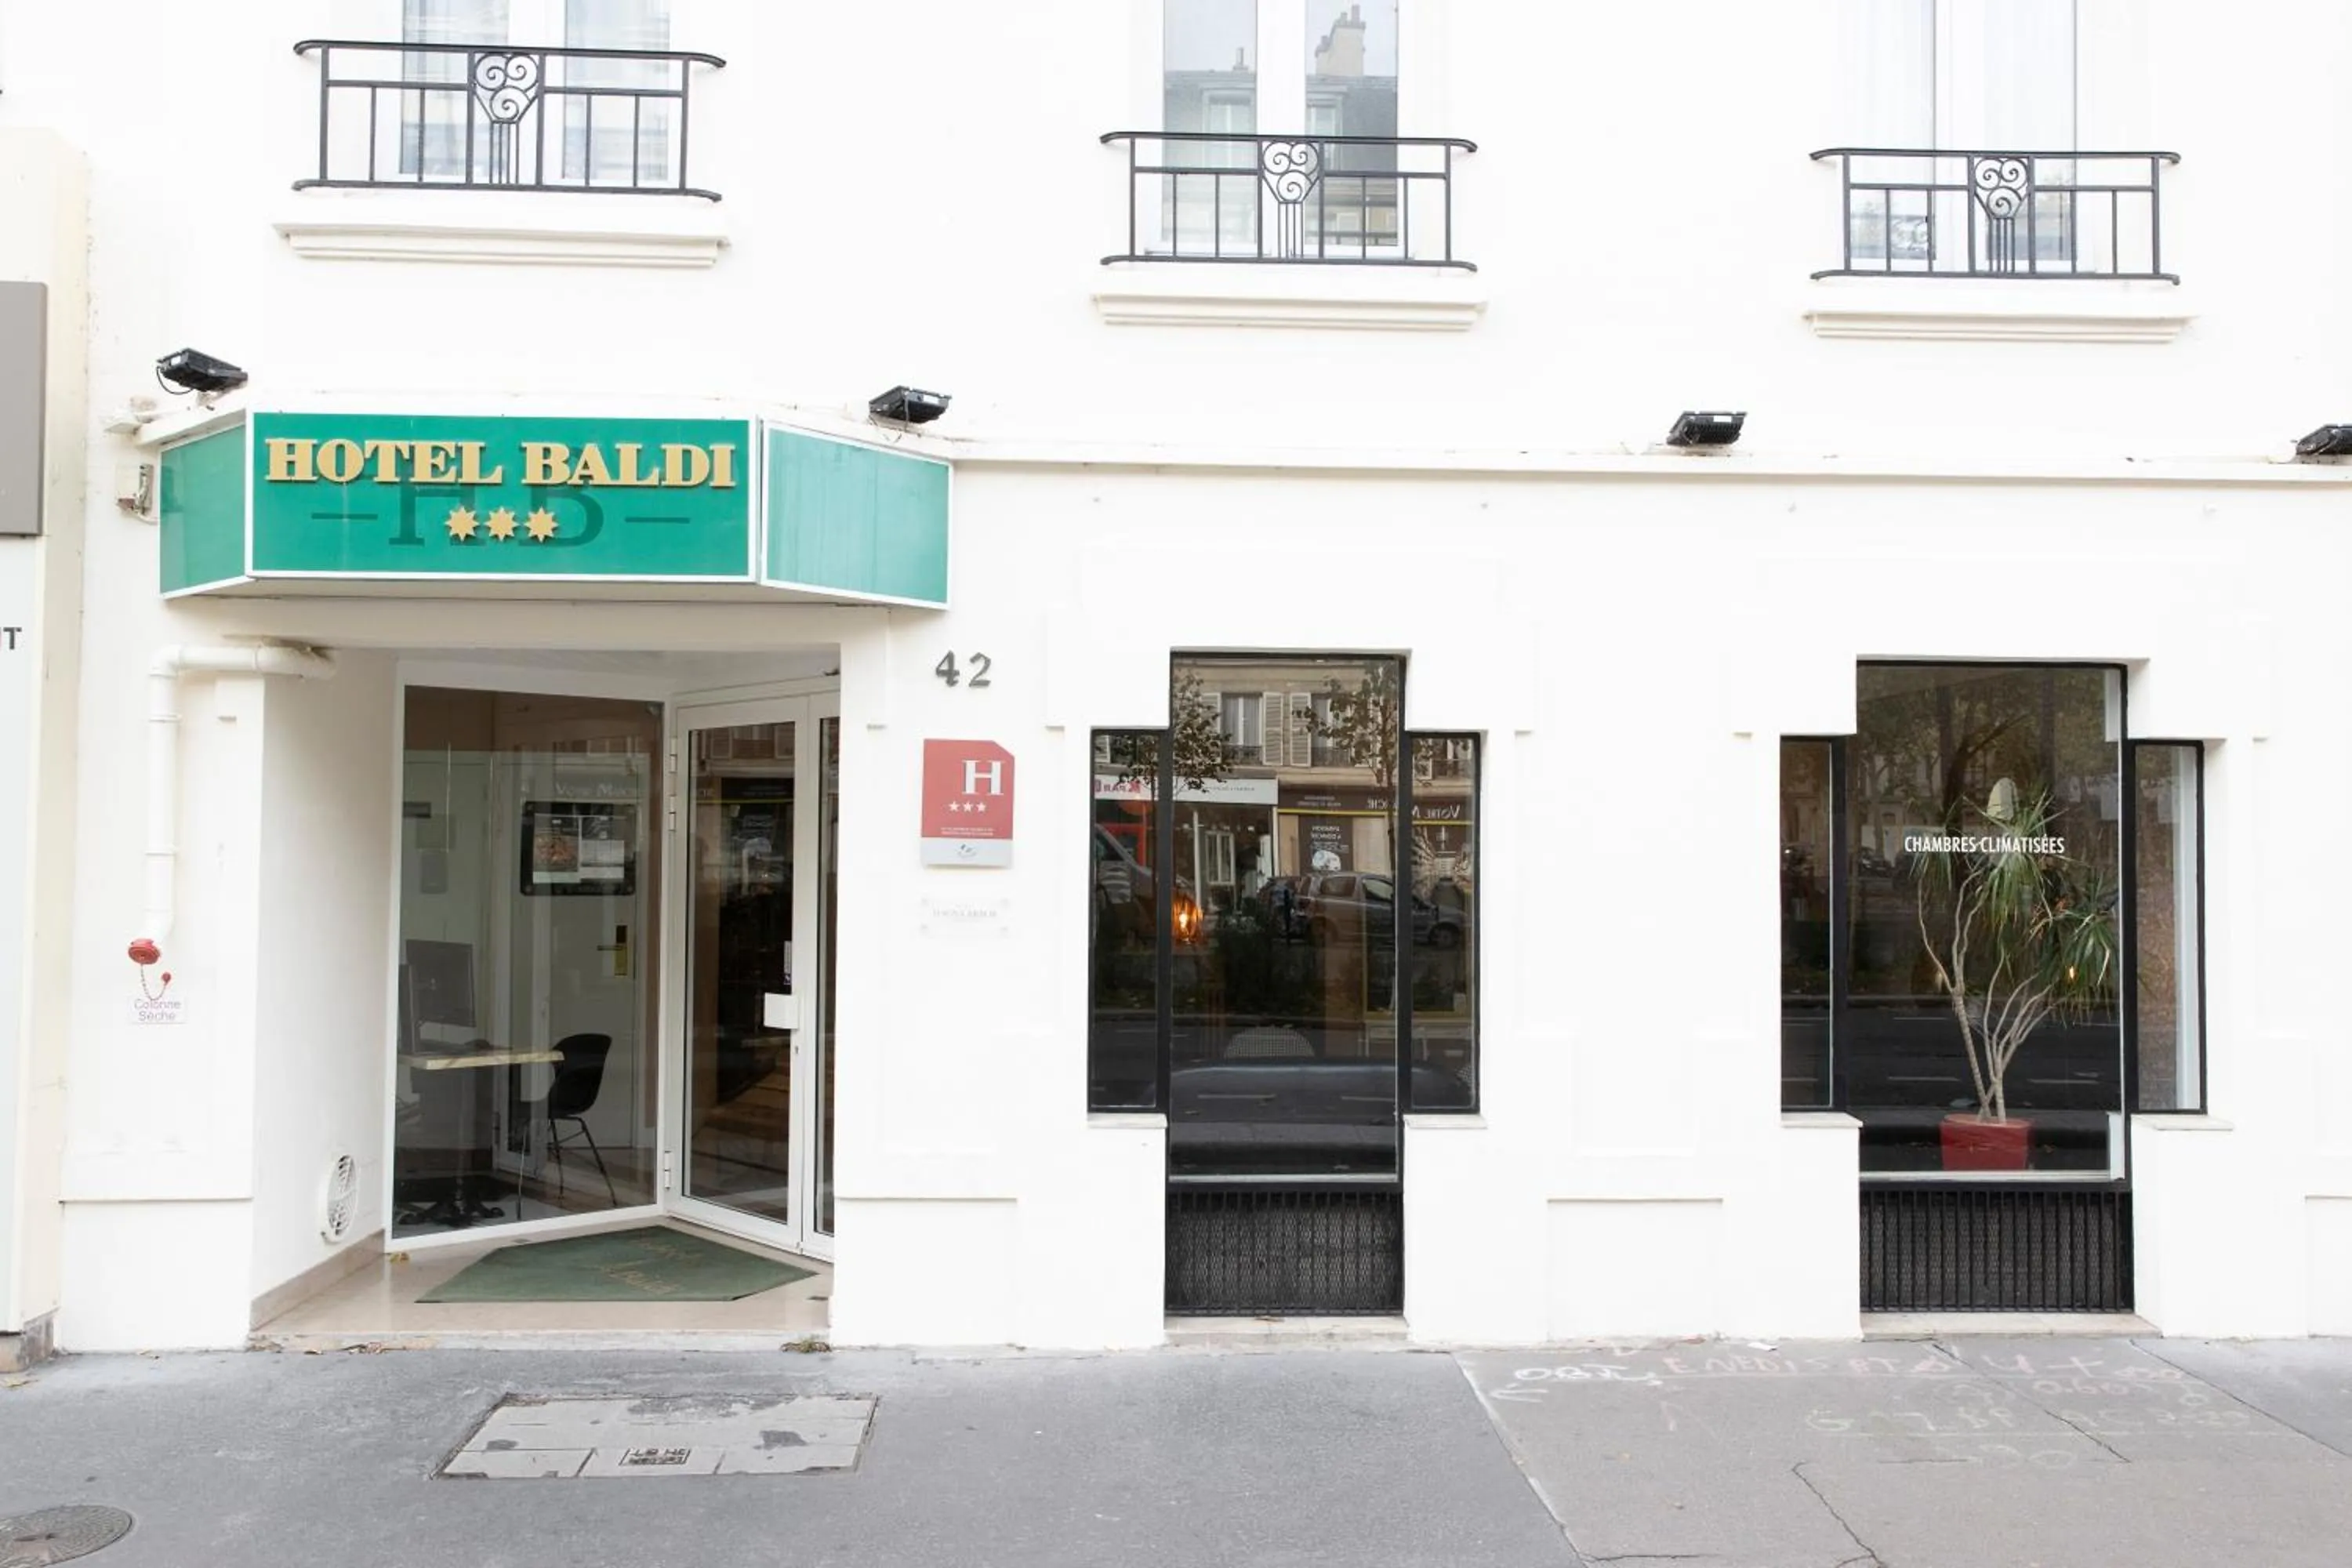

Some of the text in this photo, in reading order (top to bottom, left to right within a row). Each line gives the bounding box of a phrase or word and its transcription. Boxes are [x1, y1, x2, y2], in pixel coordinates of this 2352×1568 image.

[265, 438, 737, 488] HOTEL BALDI
[935, 650, 991, 688] 42
[961, 759, 1005, 796] H
[1904, 833, 2065, 854] CHAMBRES CLIMATISÉES
[134, 998, 182, 1010] Colonne
